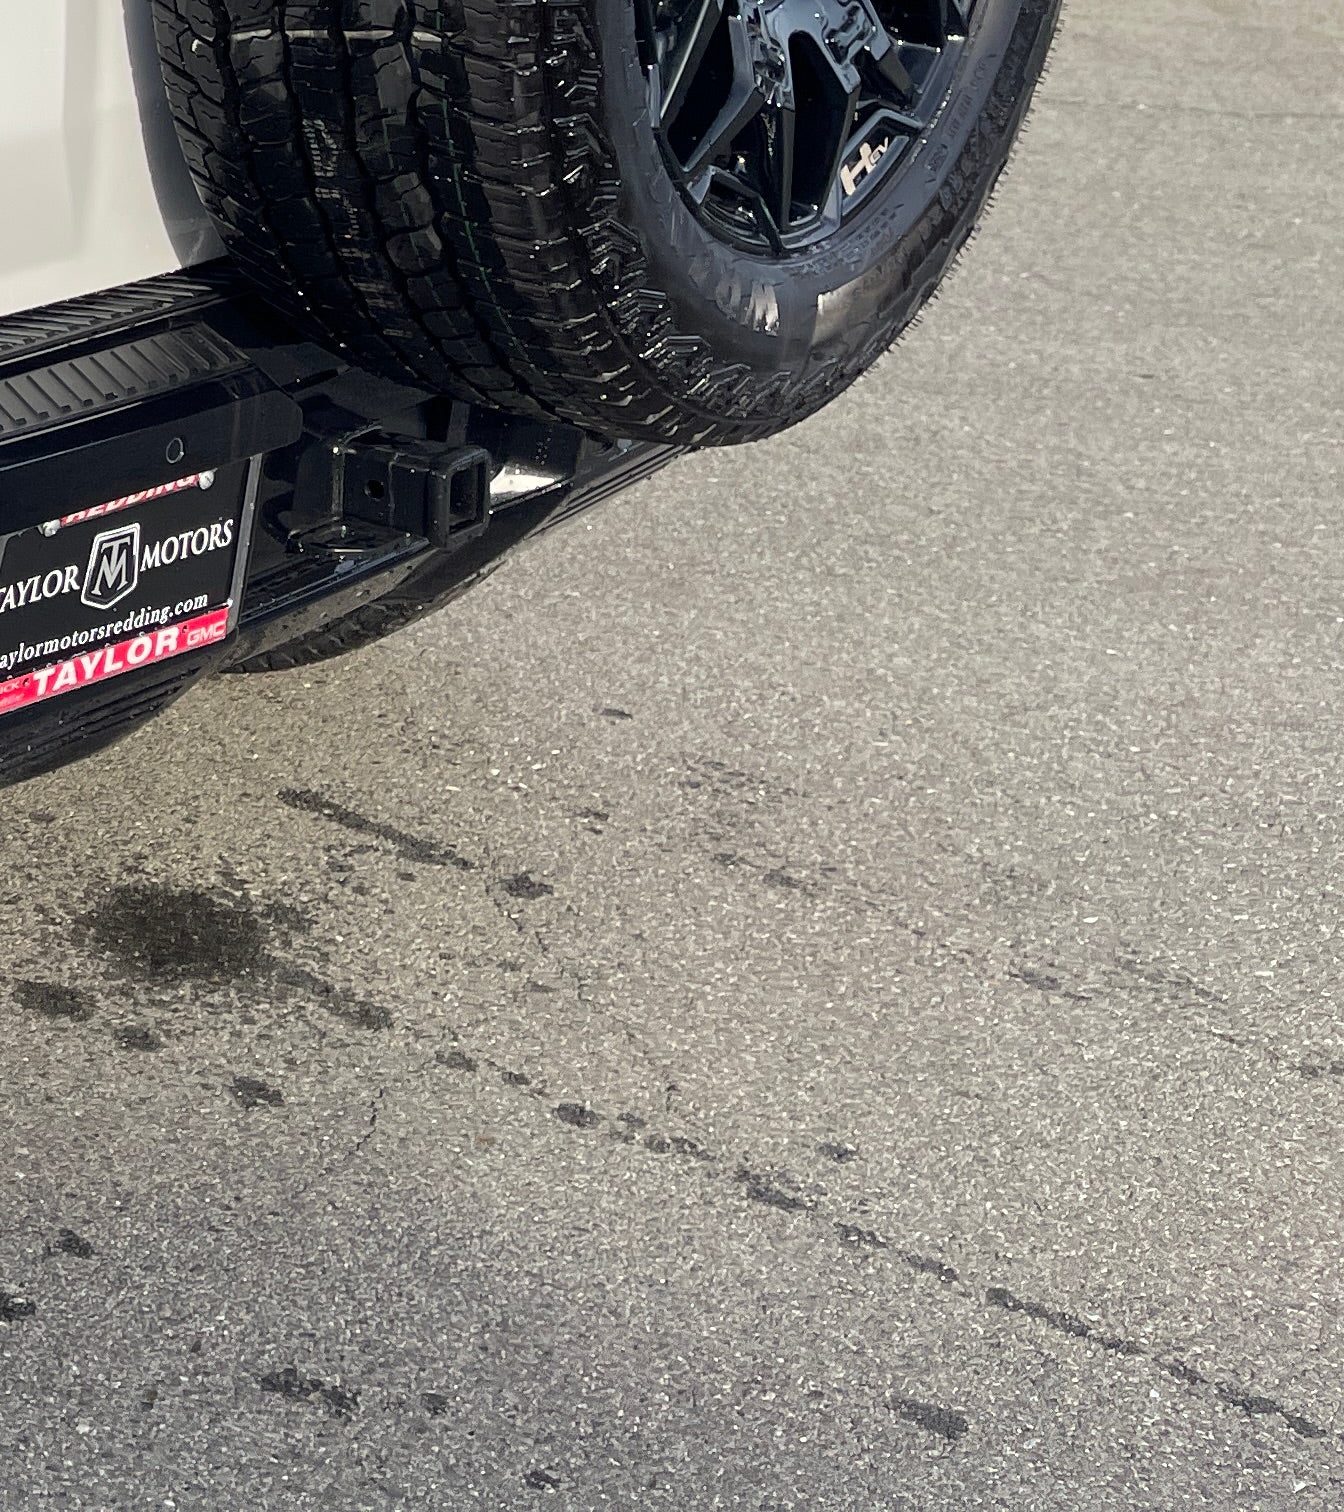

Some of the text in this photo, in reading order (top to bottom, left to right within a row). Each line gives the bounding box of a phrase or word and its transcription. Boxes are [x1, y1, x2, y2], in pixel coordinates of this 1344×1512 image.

[139, 518, 234, 572] MOTORS
[32, 626, 180, 697] TAYLOR
[186, 620, 226, 645] GMC
